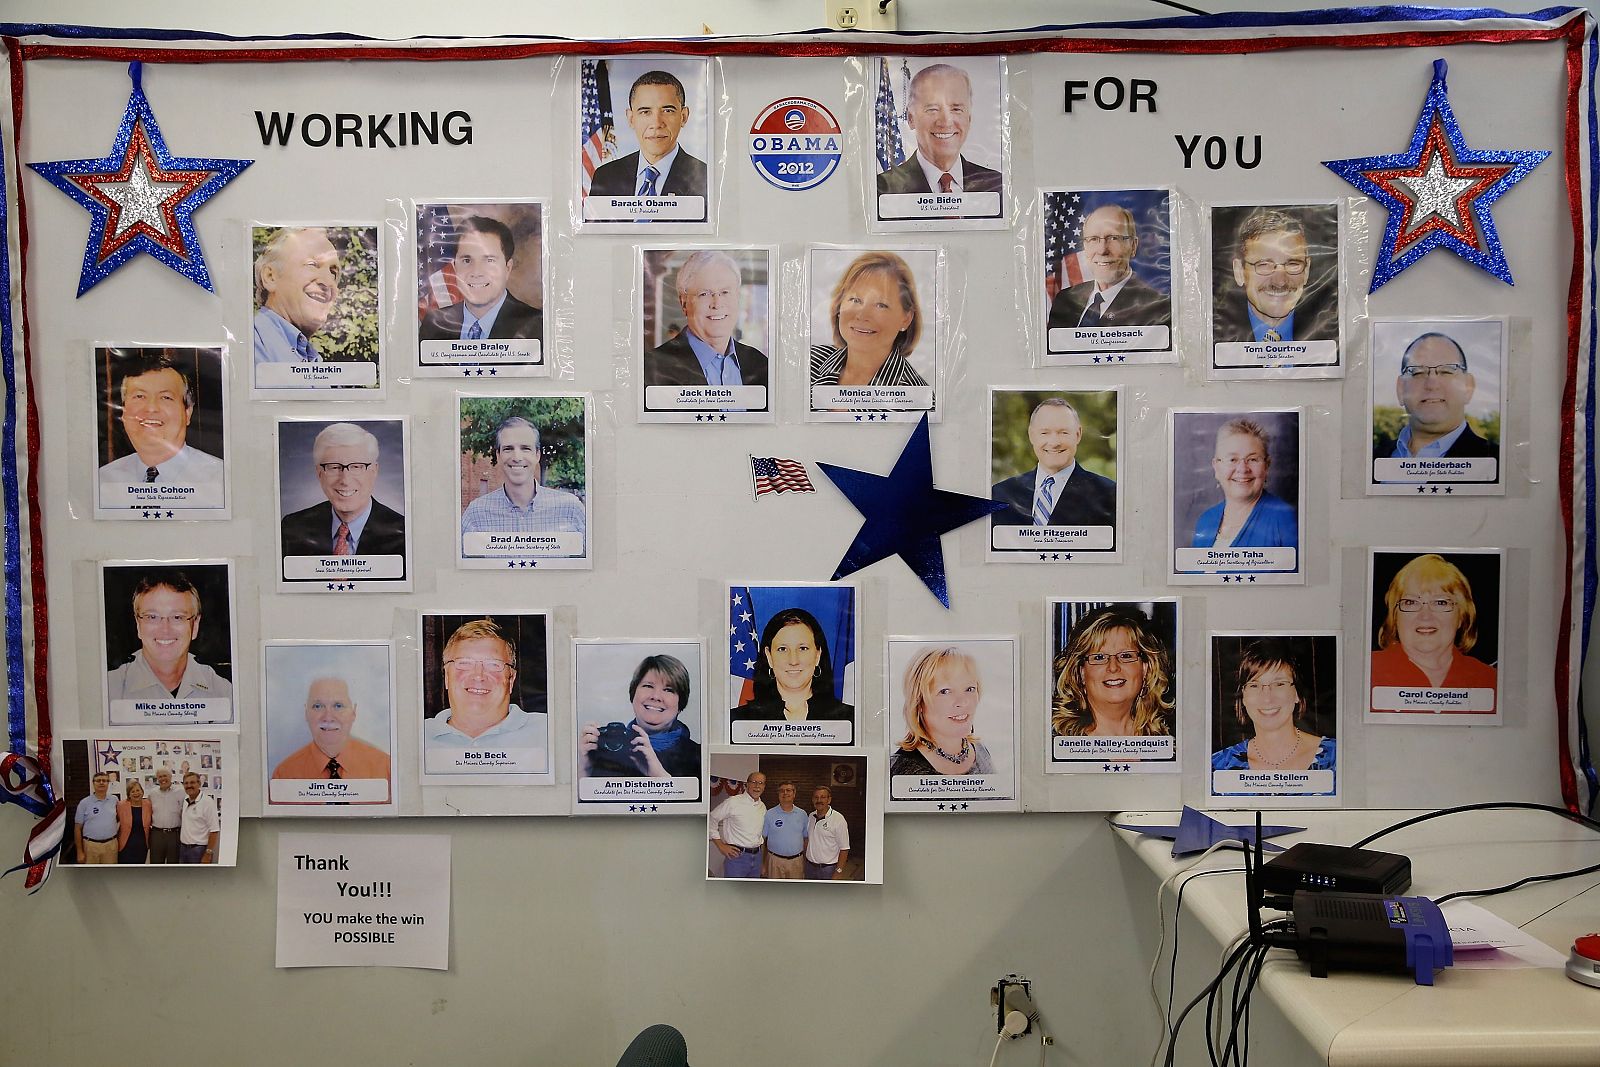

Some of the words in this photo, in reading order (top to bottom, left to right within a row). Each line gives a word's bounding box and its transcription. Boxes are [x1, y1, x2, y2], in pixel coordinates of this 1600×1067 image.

[1064, 76, 1158, 113] FOR
[254, 110, 473, 149] WORKING
[752, 137, 839, 151] OBAMA
[1174, 134, 1262, 170] YOU
[777, 162, 815, 175] 2012
[611, 199, 643, 207] Barack
[645, 199, 678, 207] Obama
[917, 197, 934, 205] Joe
[936, 196, 962, 204] Biden
[1074, 331, 1098, 339] Dave
[1100, 329, 1144, 338] Loebsack
[451, 343, 478, 351] Bruce
[480, 343, 510, 353] Braley
[1243, 345, 1263, 353] Tom
[1265, 345, 1307, 354] Courtney
[290, 366, 310, 374] Tom
[312, 366, 342, 374] Harkin
[679, 389, 702, 397] Jack
[704, 389, 732, 397] Hatch
[839, 389, 872, 397] Monica
[874, 389, 906, 397] Vernon
[1399, 461, 1417, 469] Jon
[1419, 461, 1472, 469] Neiderbach
[127, 486, 158, 494] Dennis
[160, 486, 195, 494] Cohoon
[1019, 529, 1041, 537] Mike
[1043, 529, 1088, 538] Fitzgerald
[490, 535, 511, 543] Brad
[514, 535, 556, 543] Anderson
[1207, 550, 1240, 559] Sherrie
[320, 559, 339, 567] Tom
[341, 558, 367, 566] Miller
[1398, 690, 1423, 698] Carol
[1425, 691, 1469, 700] Copeland
[135, 703, 157, 711] Mike
[158, 702, 206, 710] Johnstone
[762, 724, 782, 733] Amy
[784, 724, 822, 732] Beavers
[1058, 739, 1092, 747] Janelle
[1094, 739, 1169, 748] Nalley-Londquist
[1239, 773, 1271, 781] Brenda
[1273, 773, 1309, 781] Stellern
[308, 782, 325, 790] Jim
[327, 782, 349, 791] Cary
[605, 780, 623, 788] Ann
[624, 780, 674, 788] Distelhorst
[919, 778, 939, 786] Lisa
[941, 778, 985, 786] Schreiner
[293, 854, 350, 871] Thank
[336, 881, 392, 898] You!!!
[303, 912, 333, 924] YOU
[336, 912, 373, 924] make
[375, 912, 398, 925] the
[400, 913, 425, 925] win
[334, 931, 395, 944] POSSIBLE
